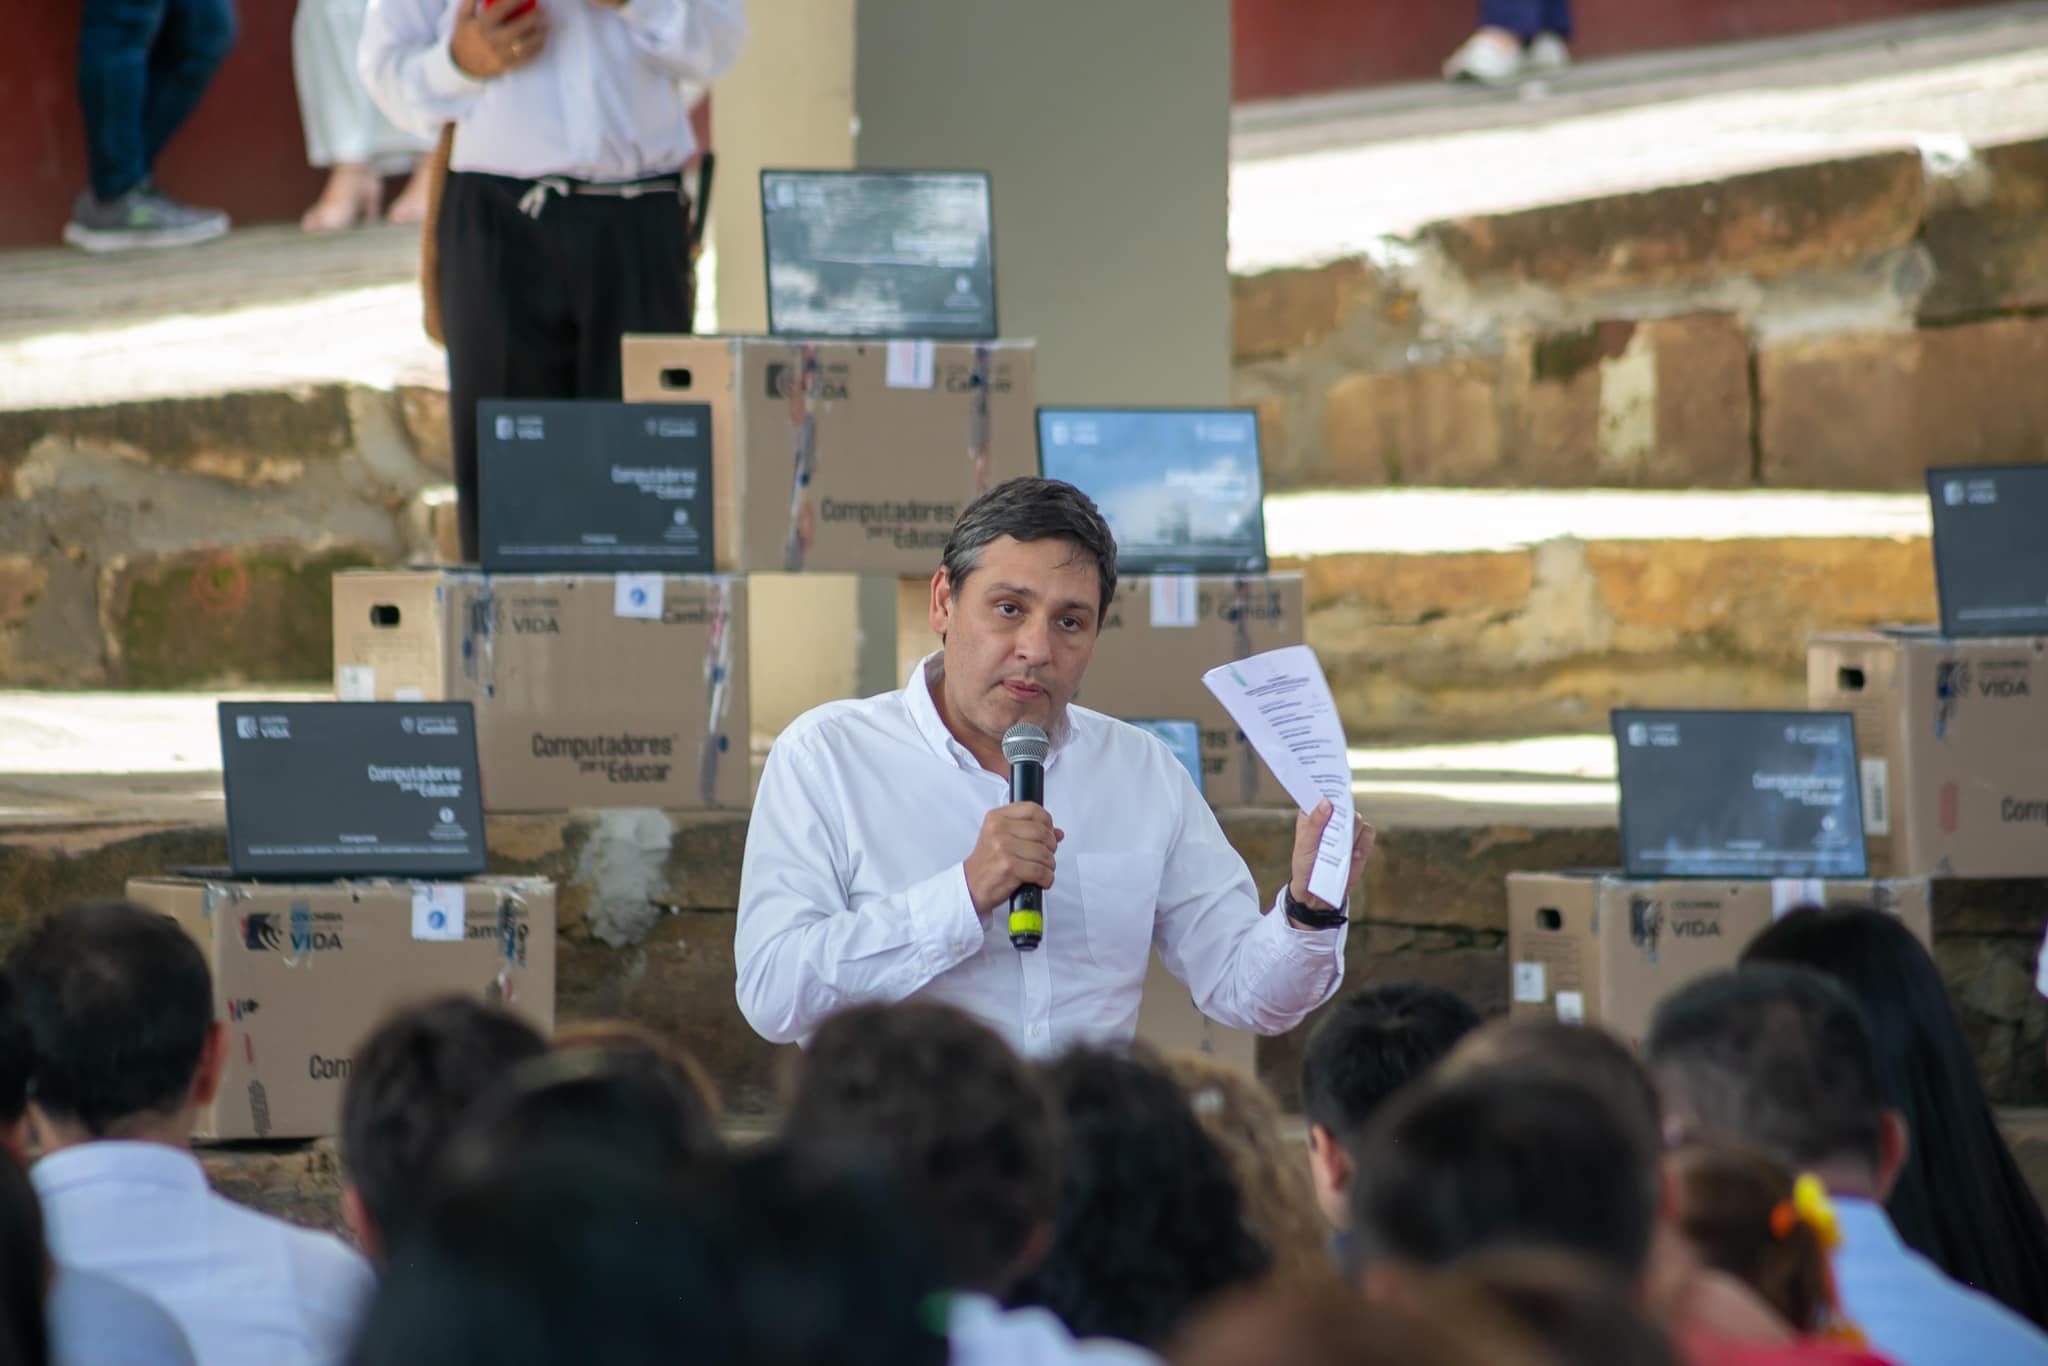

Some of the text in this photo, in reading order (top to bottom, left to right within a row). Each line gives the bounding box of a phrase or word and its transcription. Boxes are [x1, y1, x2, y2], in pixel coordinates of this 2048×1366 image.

[531, 732, 673, 762] Computadores
[608, 759, 672, 783] Educar
[290, 932, 343, 950] VIDA
[309, 1054, 353, 1081] Com
